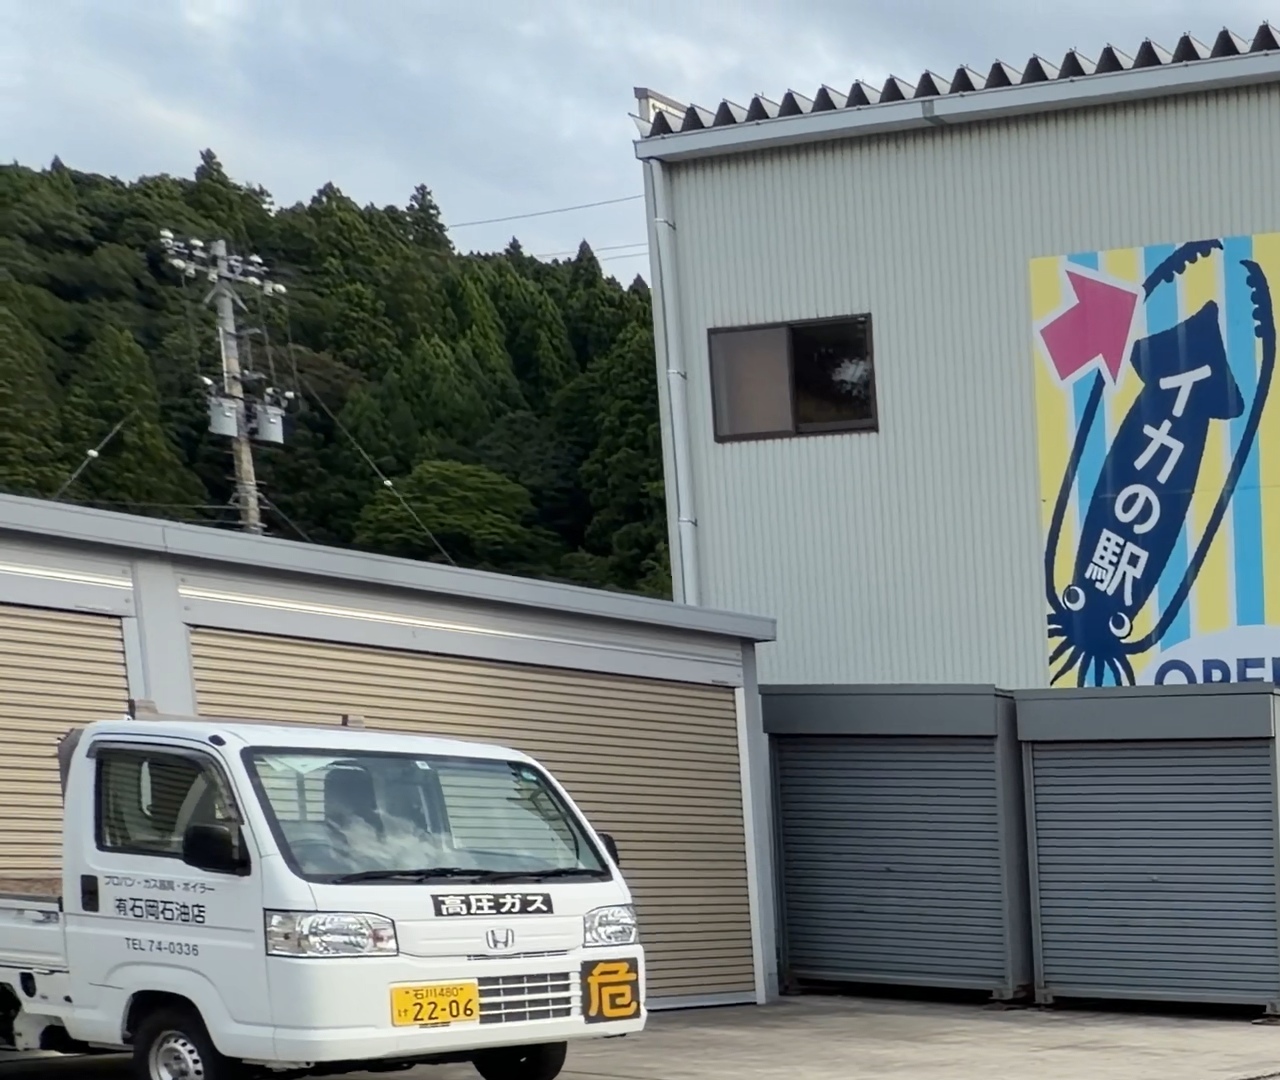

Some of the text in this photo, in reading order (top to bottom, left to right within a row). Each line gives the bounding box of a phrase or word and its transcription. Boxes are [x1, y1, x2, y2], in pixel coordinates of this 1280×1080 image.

[1085, 364, 1212, 607] イカの駅
[440, 892, 549, 916] 高圧ガス
[125, 937, 199, 957] TEL 74-0336
[587, 961, 637, 1018] 危
[412, 998, 474, 1022] 22-06
